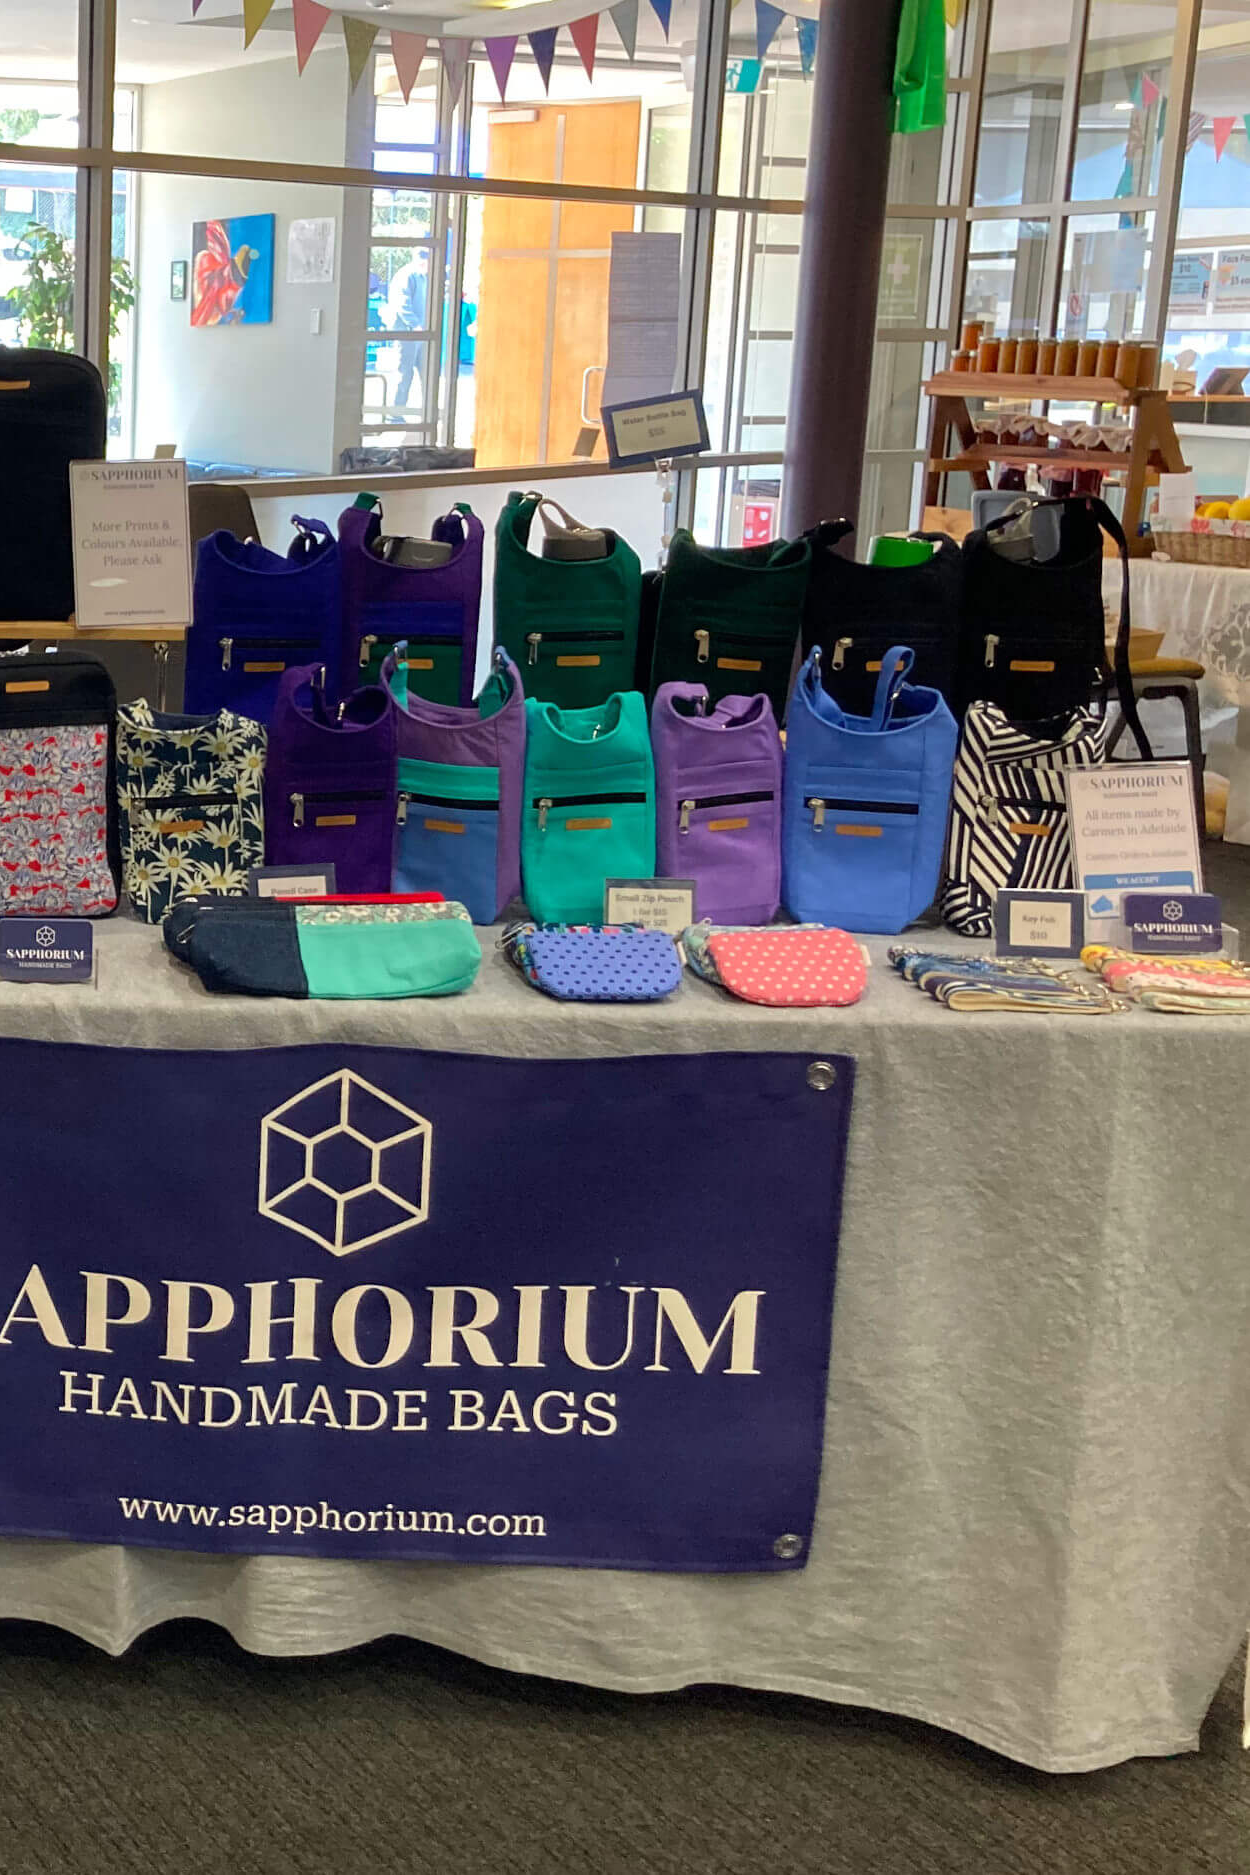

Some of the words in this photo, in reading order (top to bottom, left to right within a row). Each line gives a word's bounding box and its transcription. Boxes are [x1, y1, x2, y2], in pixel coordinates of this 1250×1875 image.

[91, 468, 178, 481] SAPPHORIUM
[92, 521, 121, 533] More
[126, 520, 159, 532] Prints
[81, 538, 126, 550] Colours
[103, 555, 138, 567] Please
[142, 554, 162, 566] Ask
[1090, 775, 1183, 790] SAPPHORIUM
[1085, 810, 1099, 821] All
[1102, 809, 1132, 820] items
[1134, 808, 1164, 819] made
[1167, 807, 1181, 820] by
[1081, 825, 1125, 837] Carmen
[1128, 825, 1138, 836] in
[1140, 823, 1186, 835] Adelaide
[615, 894, 639, 902] Small
[641, 894, 655, 904] Zip
[657, 894, 685, 903] Pouch
[1133, 922, 1214, 933] SAPPHORIUM
[6, 948, 84, 960] SAPPHORIUM
[58, 1371, 428, 1431] HANDMADE
[447, 1389, 618, 1437] BAGS
[118, 1497, 547, 1538] www.sapphorium.com
